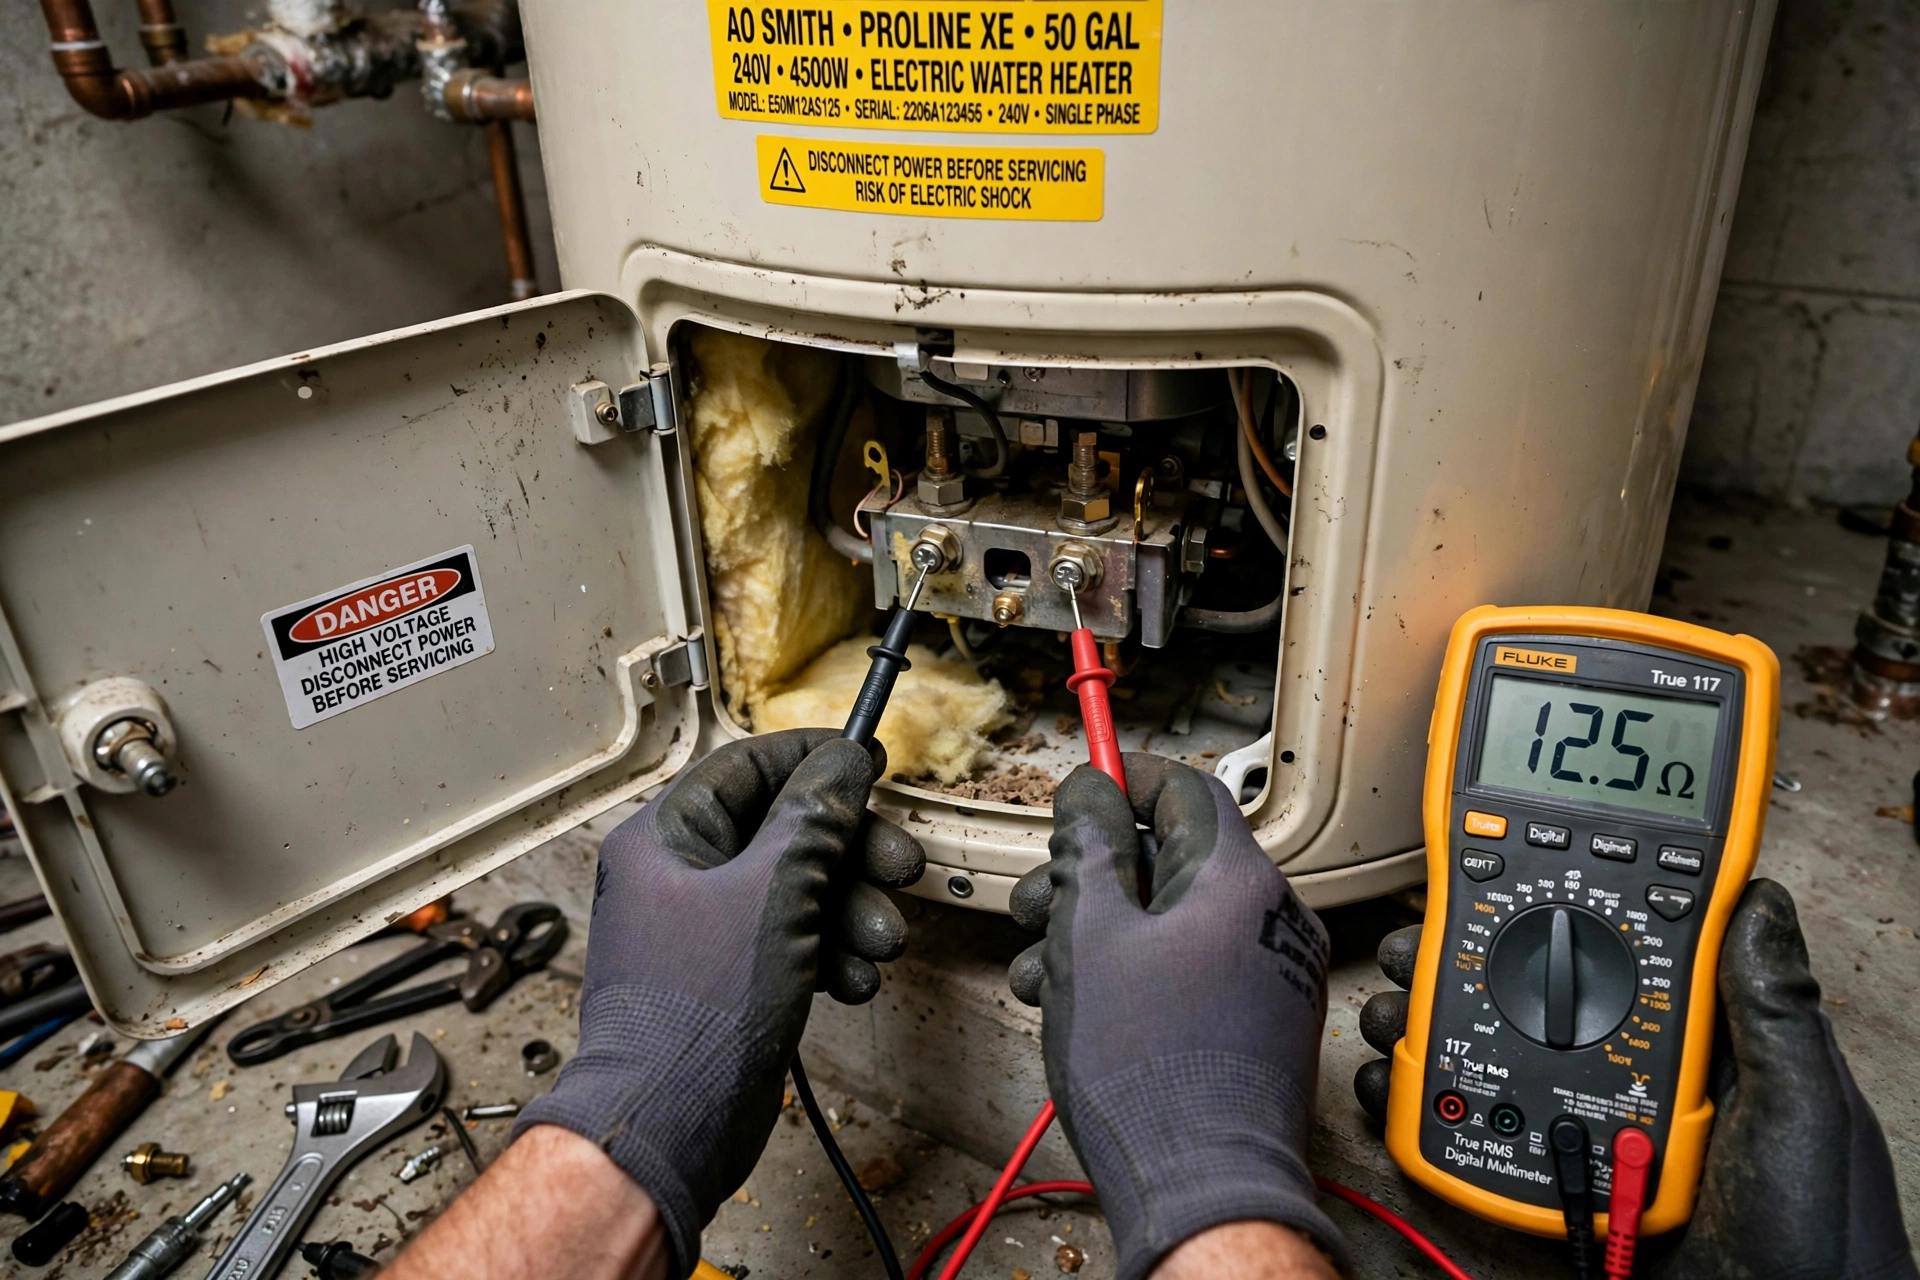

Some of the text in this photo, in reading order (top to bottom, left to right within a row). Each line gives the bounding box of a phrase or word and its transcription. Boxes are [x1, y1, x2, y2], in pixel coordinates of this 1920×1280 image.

[727, 7, 1140, 50] AO SMITH PROLINE XE 50 GAL
[732, 52, 1132, 95] 240V 4500W ELECTRIC WATER HEATER
[728, 91, 765, 113] MODEL:
[855, 99, 900, 120] SERIAL:
[999, 103, 1030, 124] 240V
[1045, 103, 1092, 125] SINGLE
[1096, 103, 1140, 124] PHASE
[808, 150, 1087, 182] DISCONNECT POWER BEFORE SERVICING
[855, 180, 1032, 209] RISK OF ELECTRIC SHOCK
[314, 575, 439, 636] DANGER
[318, 605, 451, 668] HIGH VOLTAGE
[300, 616, 476, 695] DISCONNECT POWER
[1502, 652, 1568, 669] FLUKE
[311, 637, 474, 714] BEFORE SERVICING
[1651, 669, 1722, 692] True 117
[1527, 701, 1695, 800] 12.5 Ω
[1530, 827, 1565, 843] Digital
[1445, 1037, 1472, 1056] 117
[1454, 1132, 1480, 1150] True
[1483, 1140, 1514, 1158] RMS
[1445, 1146, 1553, 1185] Digital Multimeter
